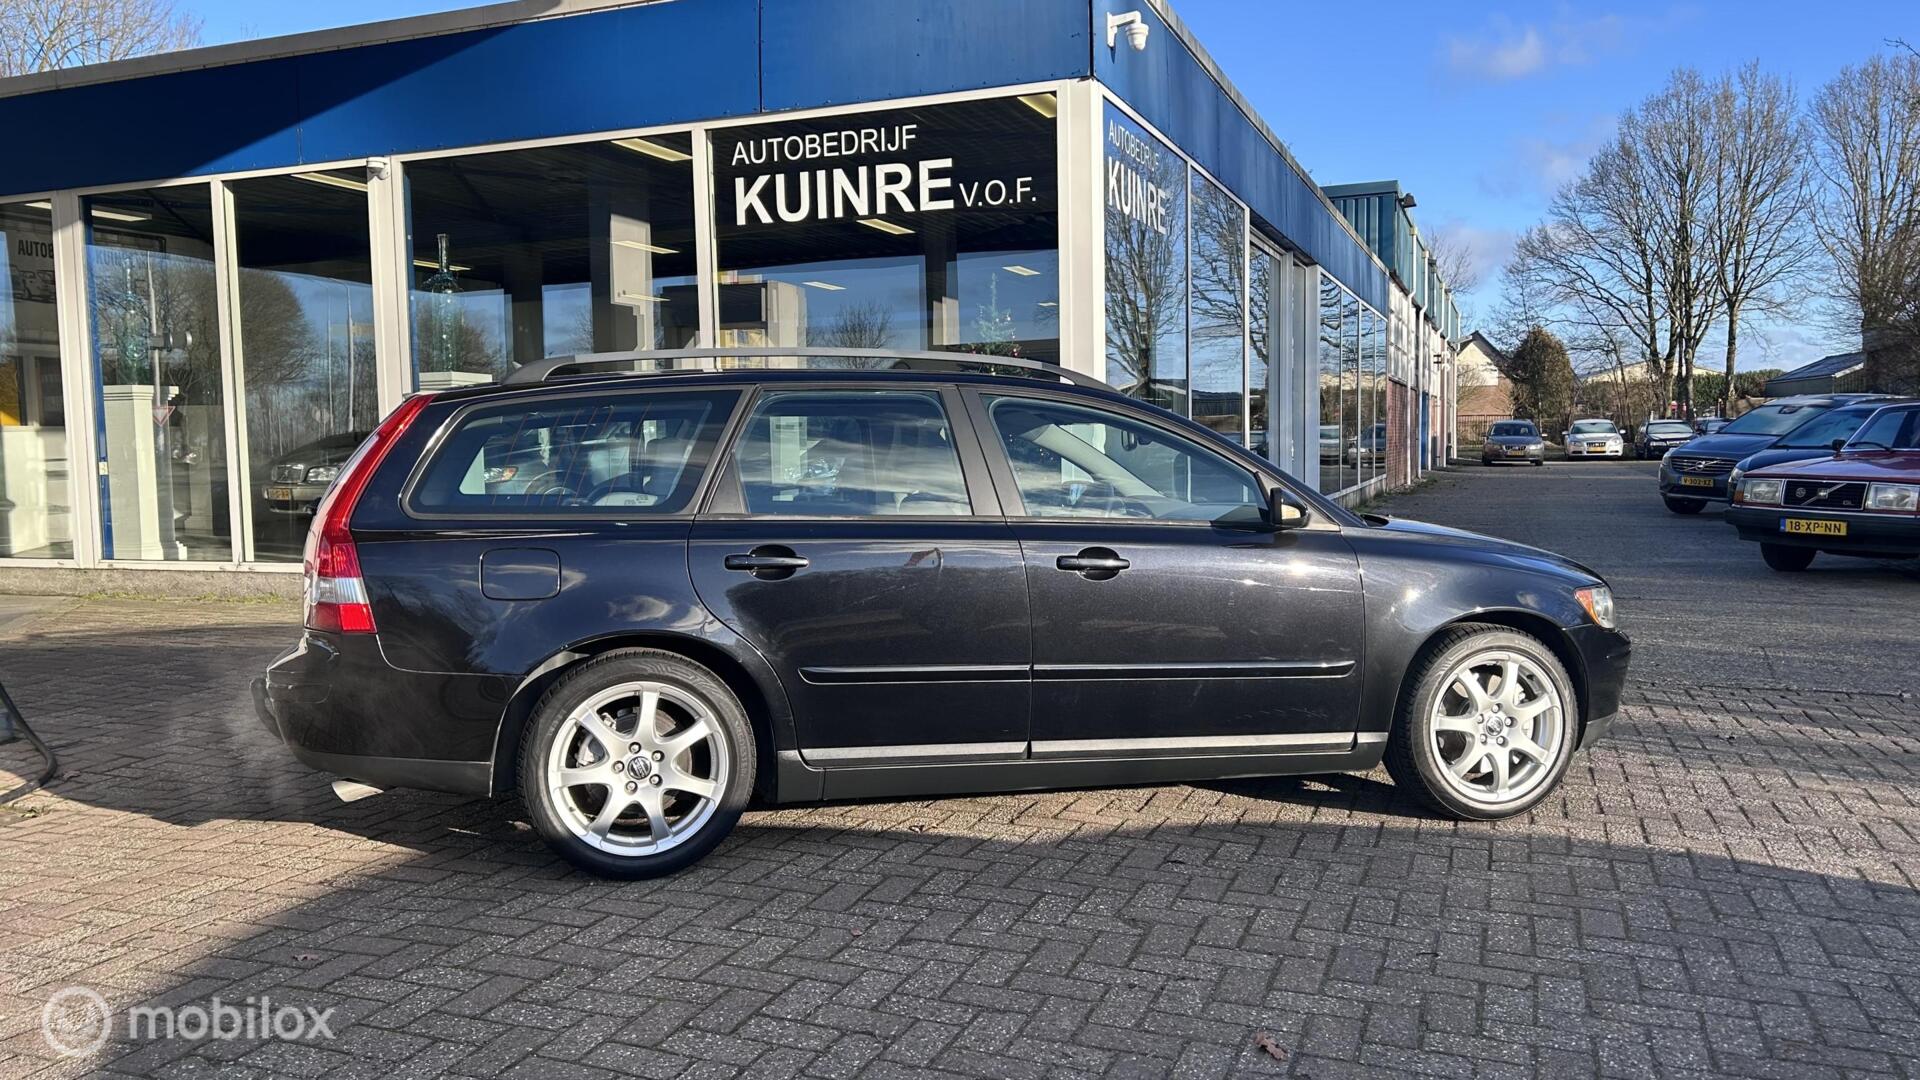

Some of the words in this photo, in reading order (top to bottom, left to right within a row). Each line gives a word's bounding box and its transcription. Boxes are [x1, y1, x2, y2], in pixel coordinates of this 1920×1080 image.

[731, 124, 917, 166] AUTOBEDRIJF
[735, 158, 955, 226] KUINRE
[959, 177, 1037, 208] V.O.F.
[1108, 156, 1166, 235] KUINRE
[1789, 520, 1842, 534] 18-XP-NN
